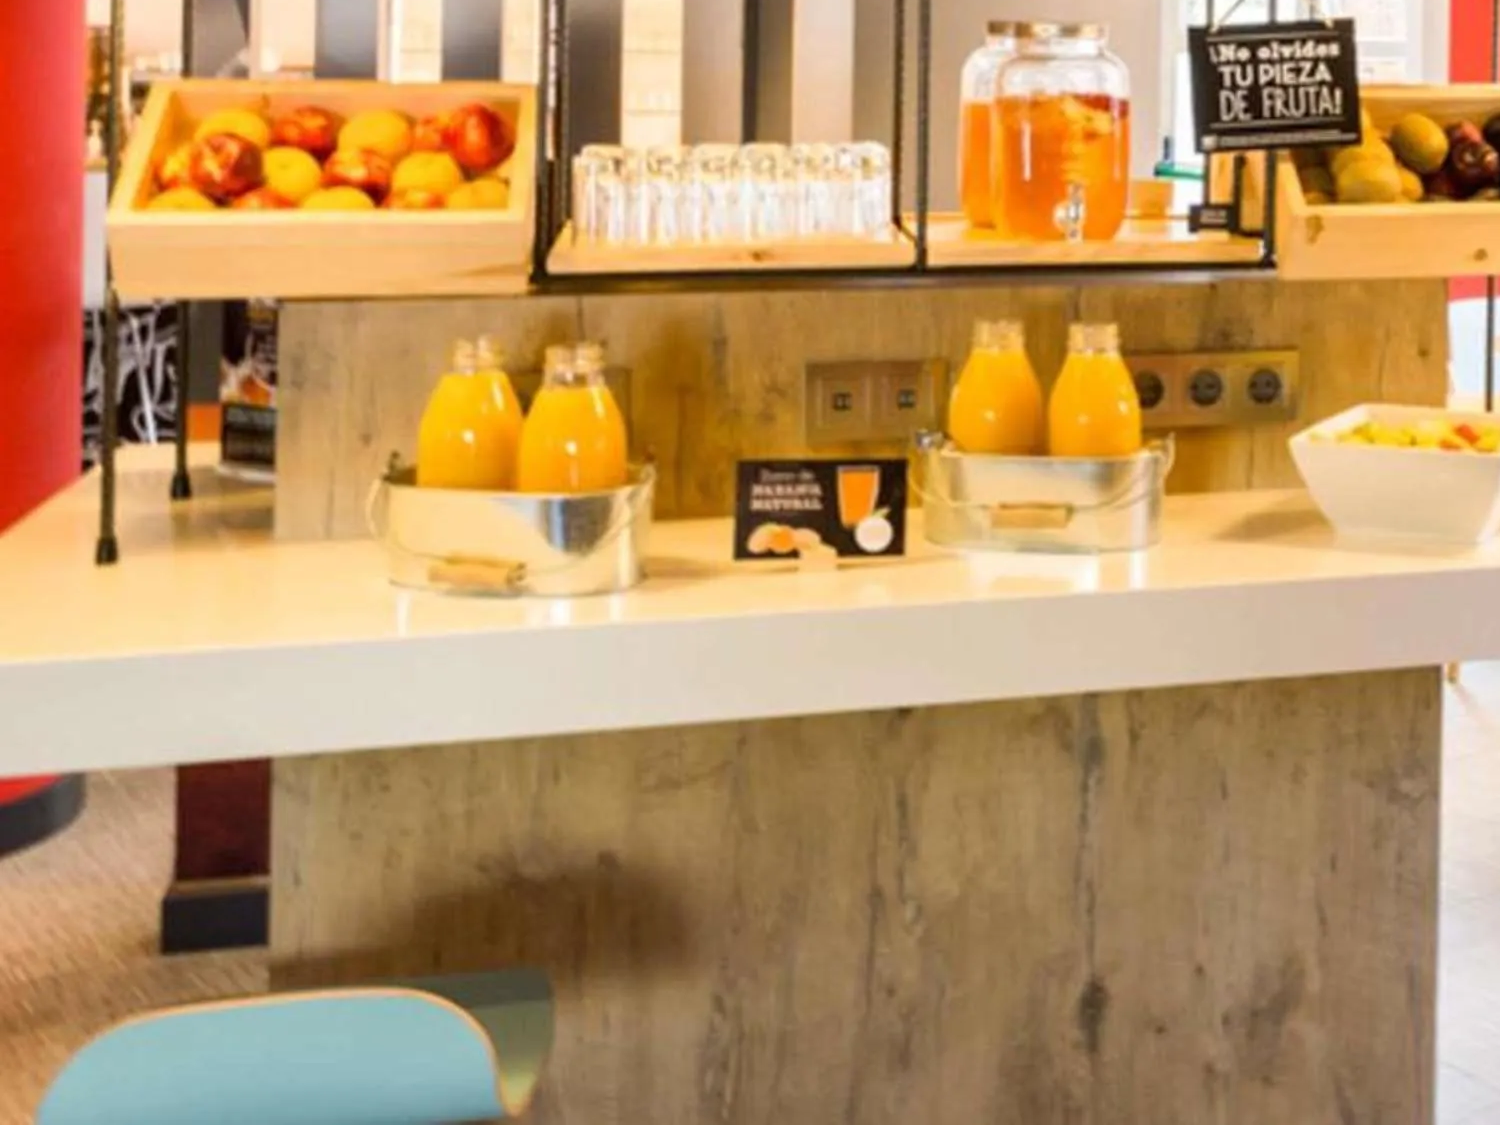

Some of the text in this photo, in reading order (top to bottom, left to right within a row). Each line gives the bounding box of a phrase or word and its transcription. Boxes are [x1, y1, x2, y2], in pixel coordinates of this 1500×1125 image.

[1257, 40, 1340, 60] olvides
[1217, 60, 1332, 87] TU PIEZA
[1219, 86, 1342, 121] DE FRUTA!
